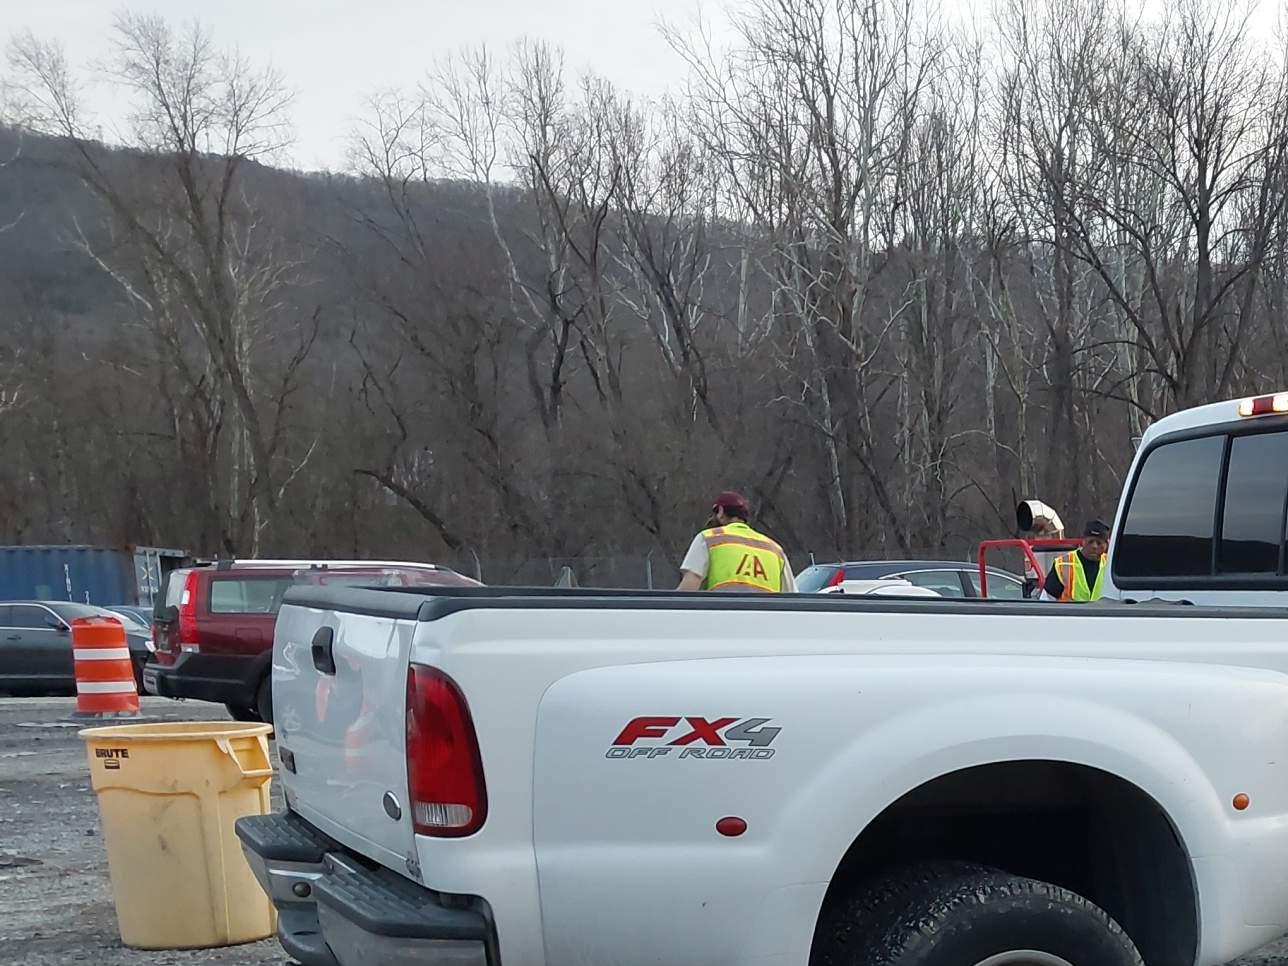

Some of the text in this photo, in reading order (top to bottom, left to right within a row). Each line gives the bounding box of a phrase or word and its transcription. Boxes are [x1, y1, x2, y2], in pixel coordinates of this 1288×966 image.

[611, 716, 783, 747] FX4
[95, 748, 129, 759] BRUTE
[605, 747, 776, 760] OFF ROAD
